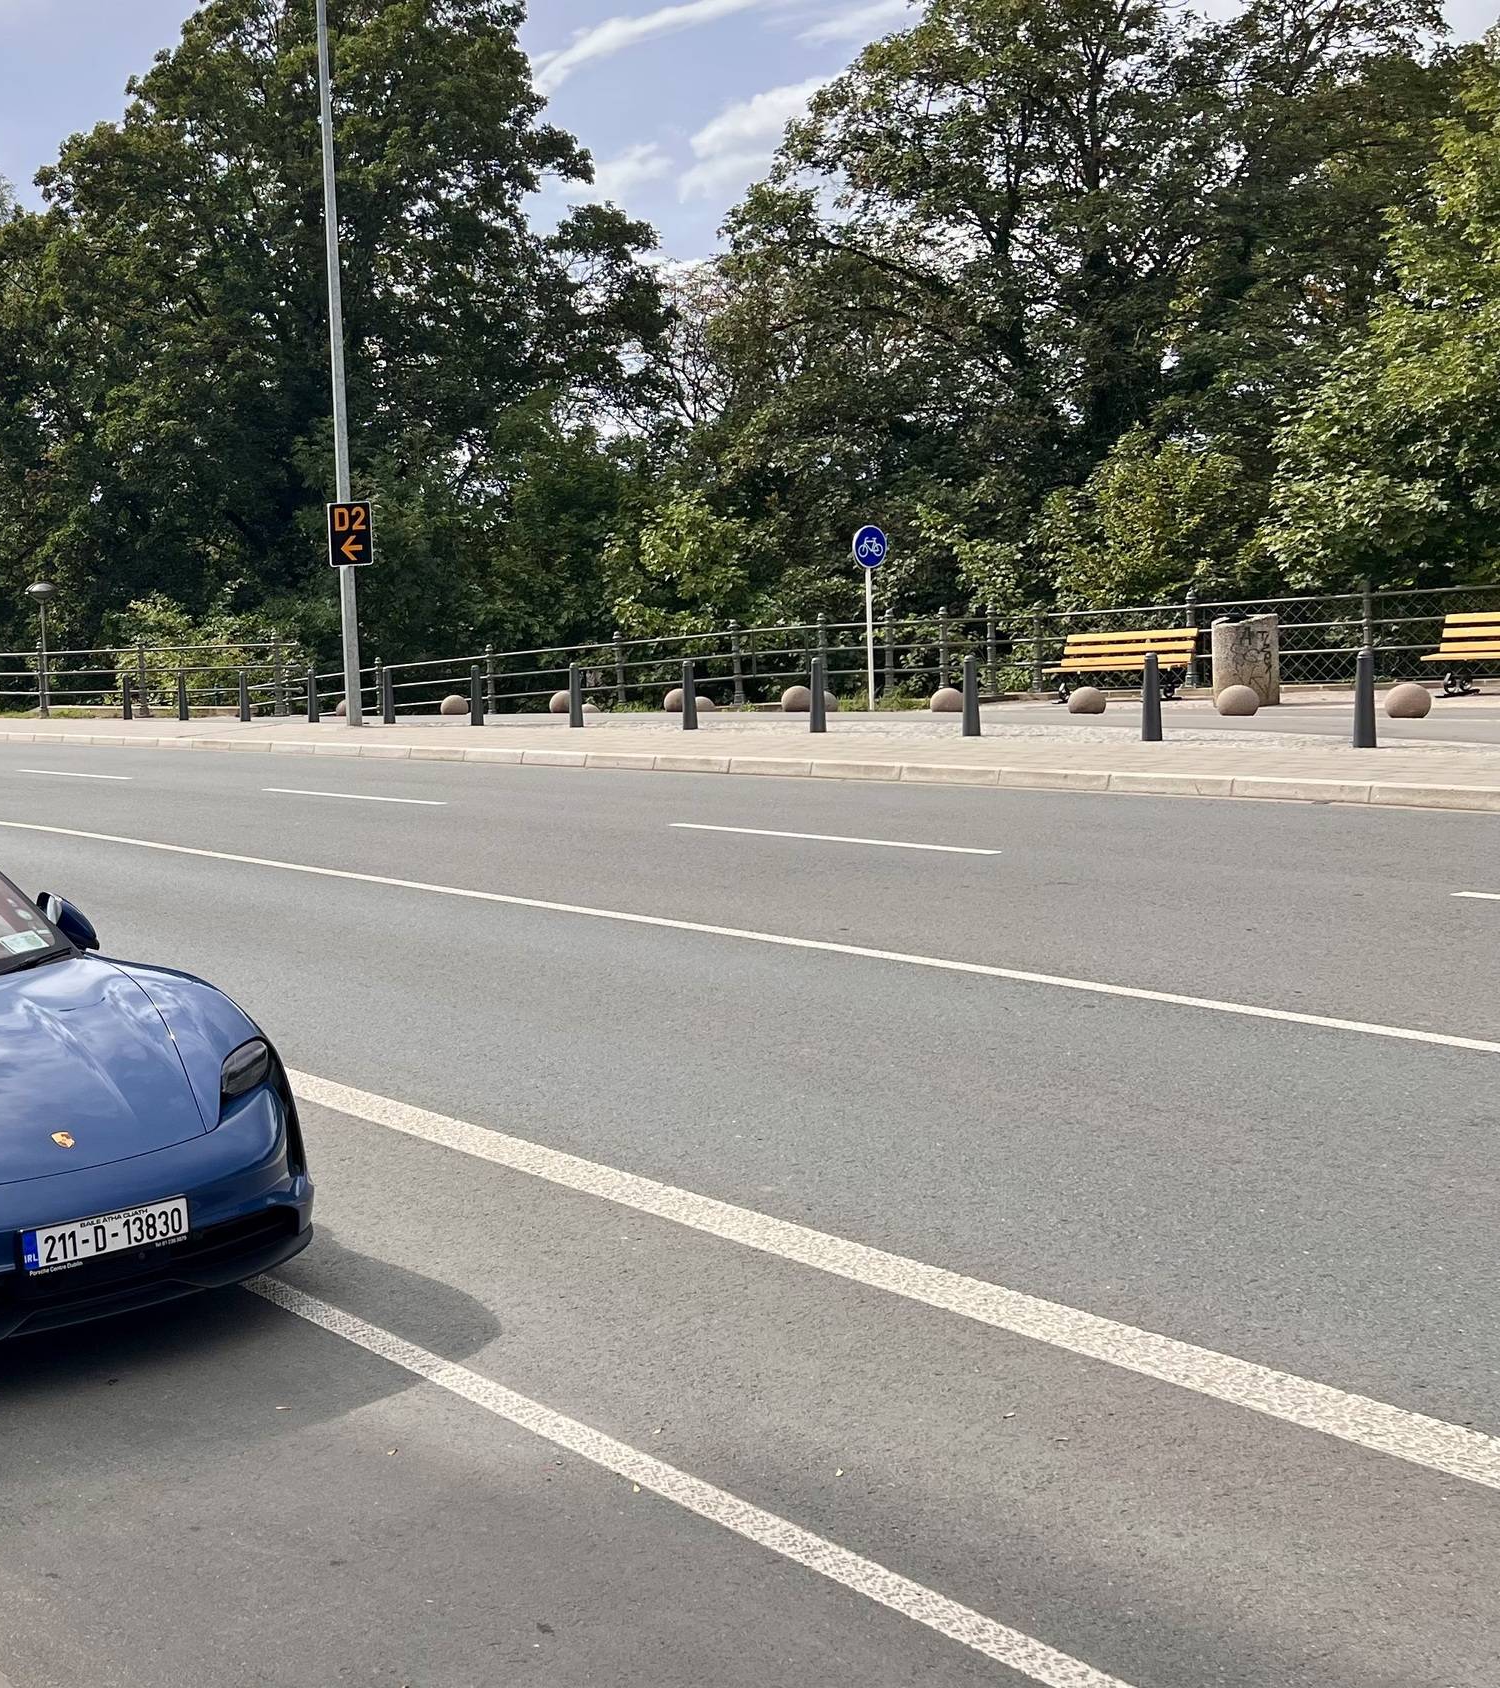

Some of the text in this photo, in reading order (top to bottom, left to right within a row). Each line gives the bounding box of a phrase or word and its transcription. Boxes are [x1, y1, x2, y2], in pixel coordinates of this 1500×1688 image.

[334, 506, 366, 531] D2
[44, 1207, 183, 1264] 211-D-13830
[24, 1253, 39, 1264] IRL
